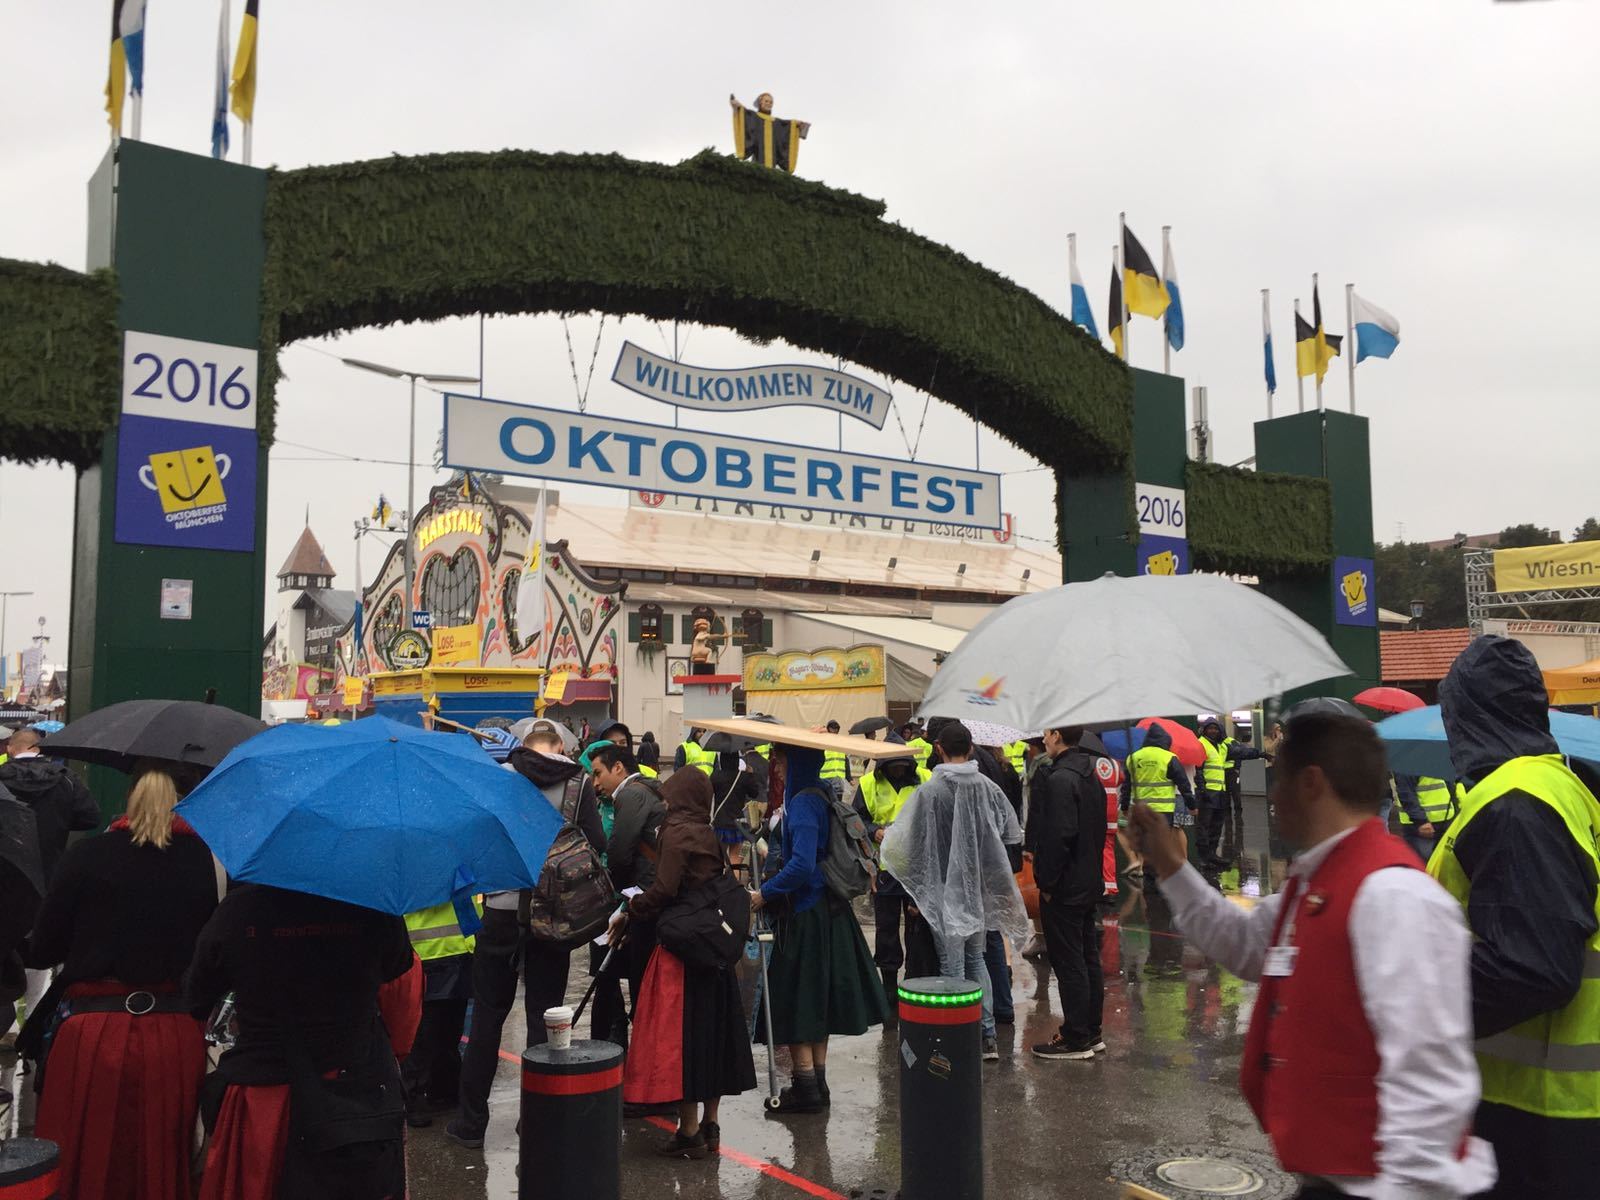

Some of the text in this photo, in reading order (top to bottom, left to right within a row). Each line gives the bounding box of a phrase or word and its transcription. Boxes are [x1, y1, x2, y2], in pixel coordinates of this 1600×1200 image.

[131, 352, 251, 410] 2016
[636, 356, 873, 415] WILLKOMMEN ZUM
[498, 415, 984, 517] OKTOBERFEST
[165, 503, 227, 522] OKTOBERFEST
[1138, 495, 1184, 528] 2016
[414, 614, 430, 625] WC
[437, 631, 454, 651] Lose
[464, 673, 489, 685] Lose
